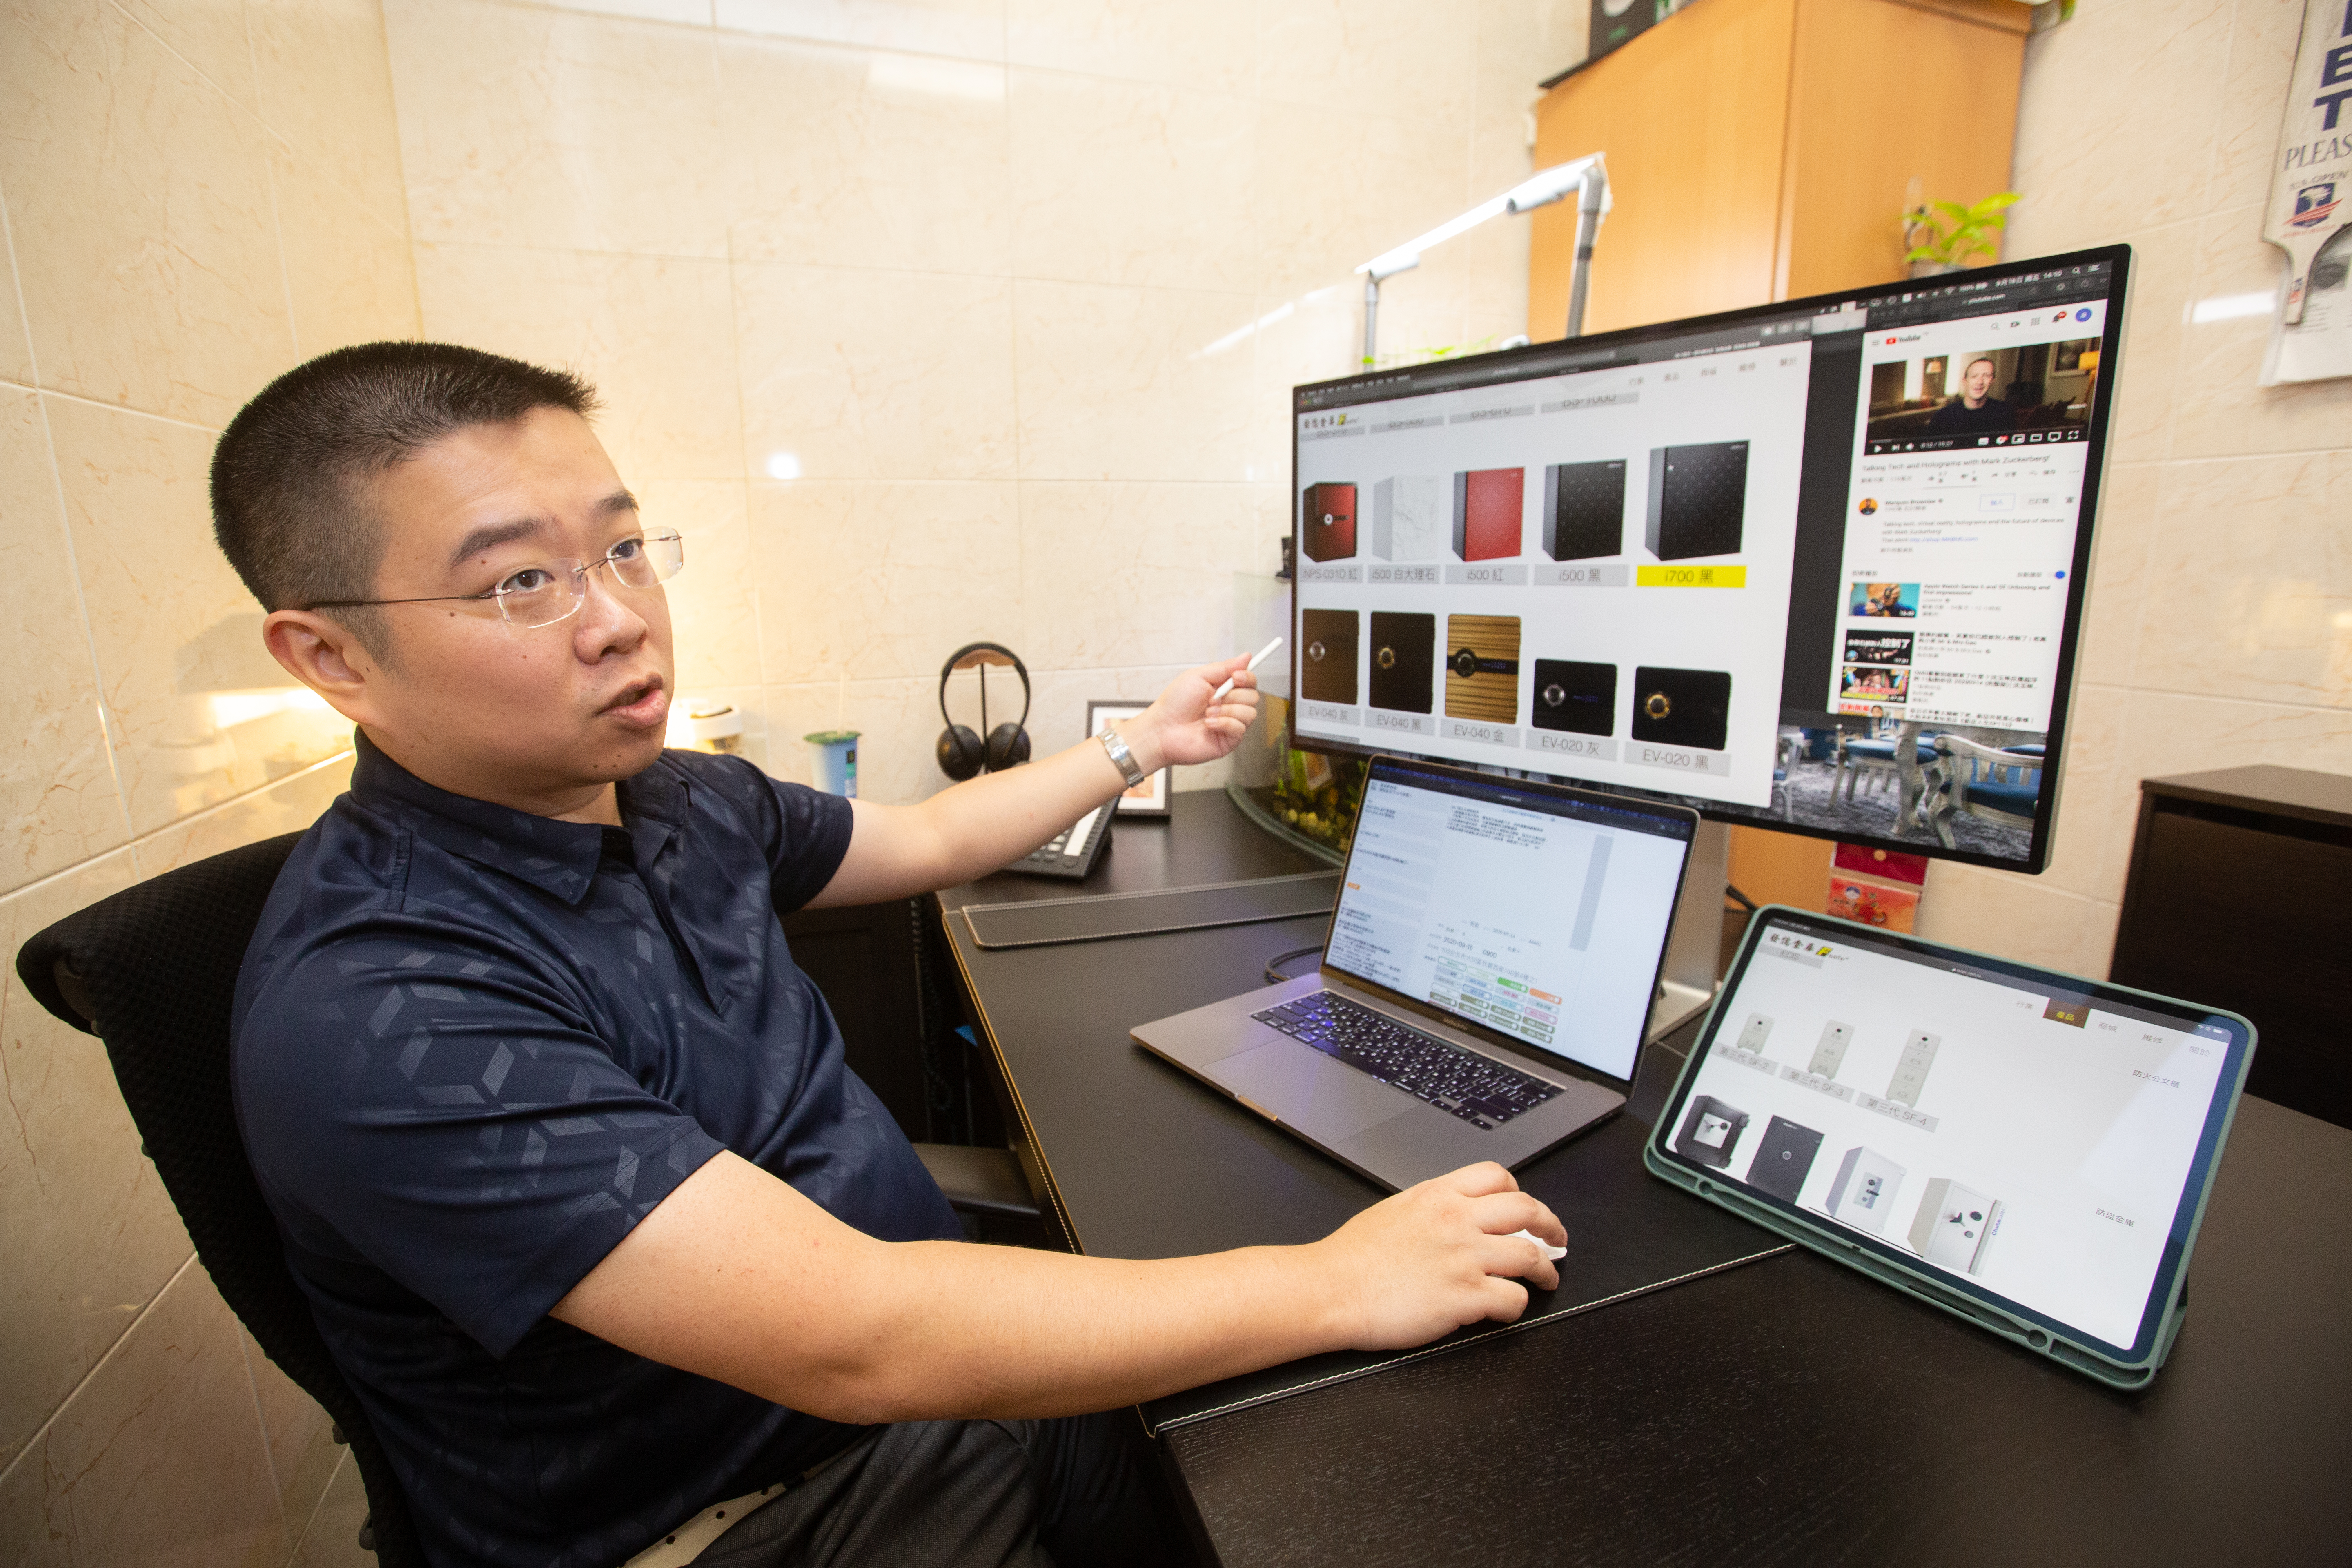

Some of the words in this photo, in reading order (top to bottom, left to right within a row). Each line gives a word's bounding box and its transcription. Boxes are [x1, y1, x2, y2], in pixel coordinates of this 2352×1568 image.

[1394, 568, 1435, 581] 白大理石
[1467, 569, 1489, 581] i500
[1492, 568, 1504, 581] 紅
[1559, 569, 1585, 582] i500
[1588, 568, 1601, 583] 黑
[1664, 569, 1695, 583] i700
[1699, 568, 1714, 584] 黑
[1377, 714, 1409, 728] EV-040
[1411, 719, 1421, 731] 黑
[1454, 724, 1490, 740] EV-040
[1493, 729, 1504, 743] 金
[1541, 736, 1584, 753] EV-020
[1586, 742, 1600, 755] 灰
[1643, 748, 1691, 766] EV-020
[1694, 755, 1710, 771] 黑
[2098, 1022, 2118, 1033] 商城
[2141, 1033, 2163, 1045] 維修
[2188, 1045, 2211, 1057] 關於
[1789, 1071, 1819, 1089] 第三代
[1822, 1082, 1844, 1096] SF-3
[2132, 1069, 2180, 1089] 防火公文櫃
[1866, 1098, 1900, 1117] 第三代
[1902, 1111, 1927, 1125] SF-4
[2095, 1207, 2135, 1228] 防盜金庫
